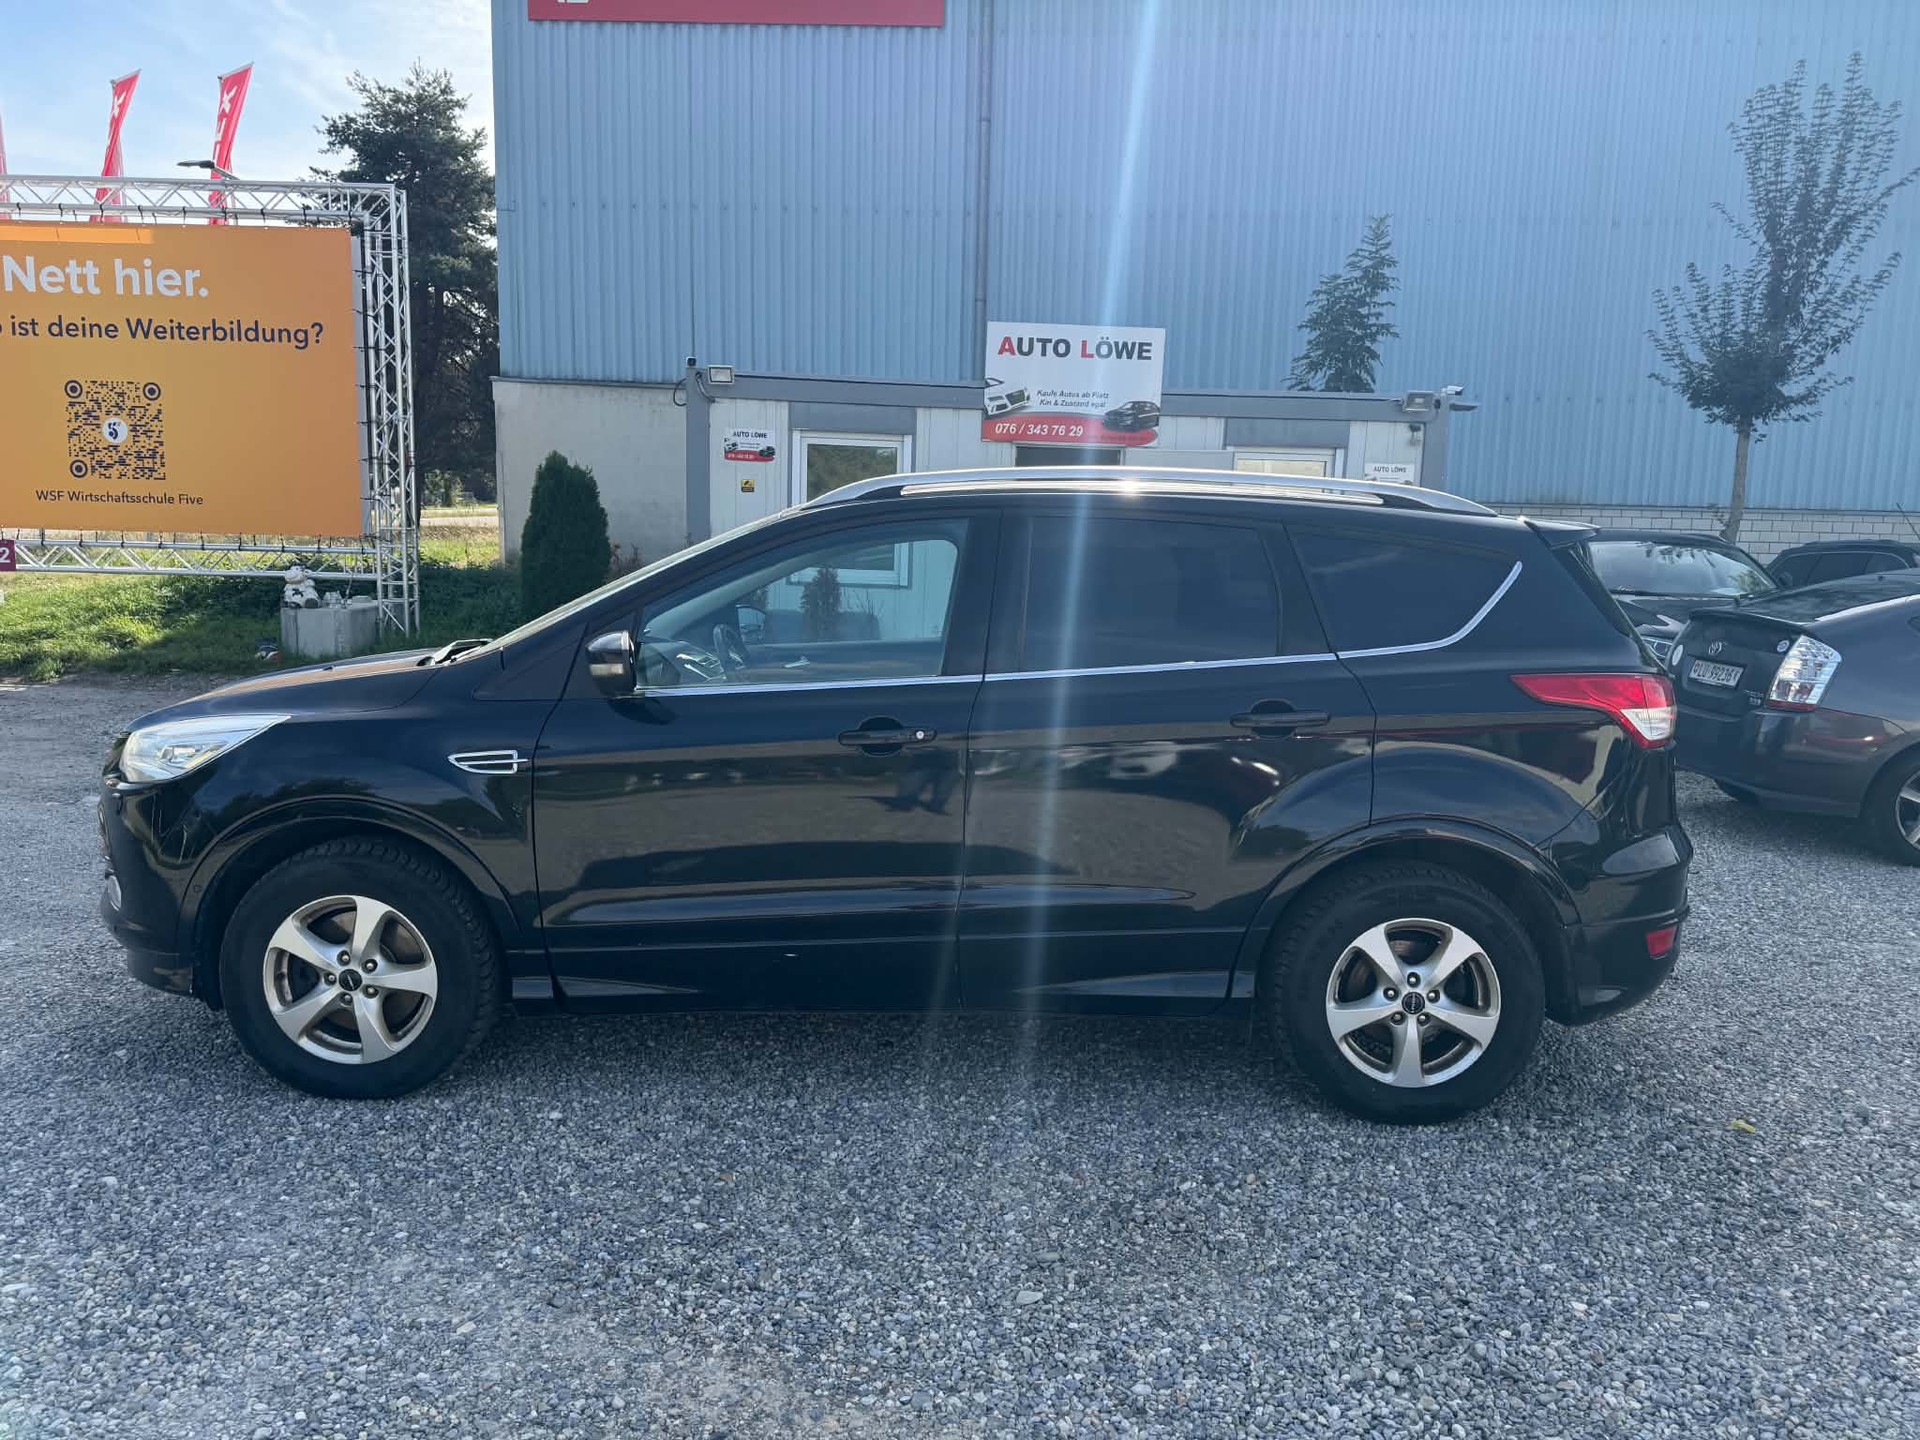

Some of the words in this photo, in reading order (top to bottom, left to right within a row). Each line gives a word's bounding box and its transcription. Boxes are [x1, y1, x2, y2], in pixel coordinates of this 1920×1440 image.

[2, 254, 101, 295] Nett
[114, 257, 209, 298] hier.
[10, 315, 39, 337] ist
[47, 315, 119, 339] deine
[125, 317, 324, 351] Weiterbildung?
[998, 336, 1071, 358] AUTO
[1081, 336, 1153, 361] LÖWE
[1036, 389, 1057, 397] Kaufe
[995, 422, 1017, 435] 076
[1018, 422, 1025, 435] /
[1027, 424, 1048, 436] 343
[1051, 424, 1066, 436] 76
[1068, 425, 1084, 437] 29
[35, 490, 65, 501] WSF
[67, 490, 175, 505] Wirtschaftsschule
[178, 493, 204, 505] Five
